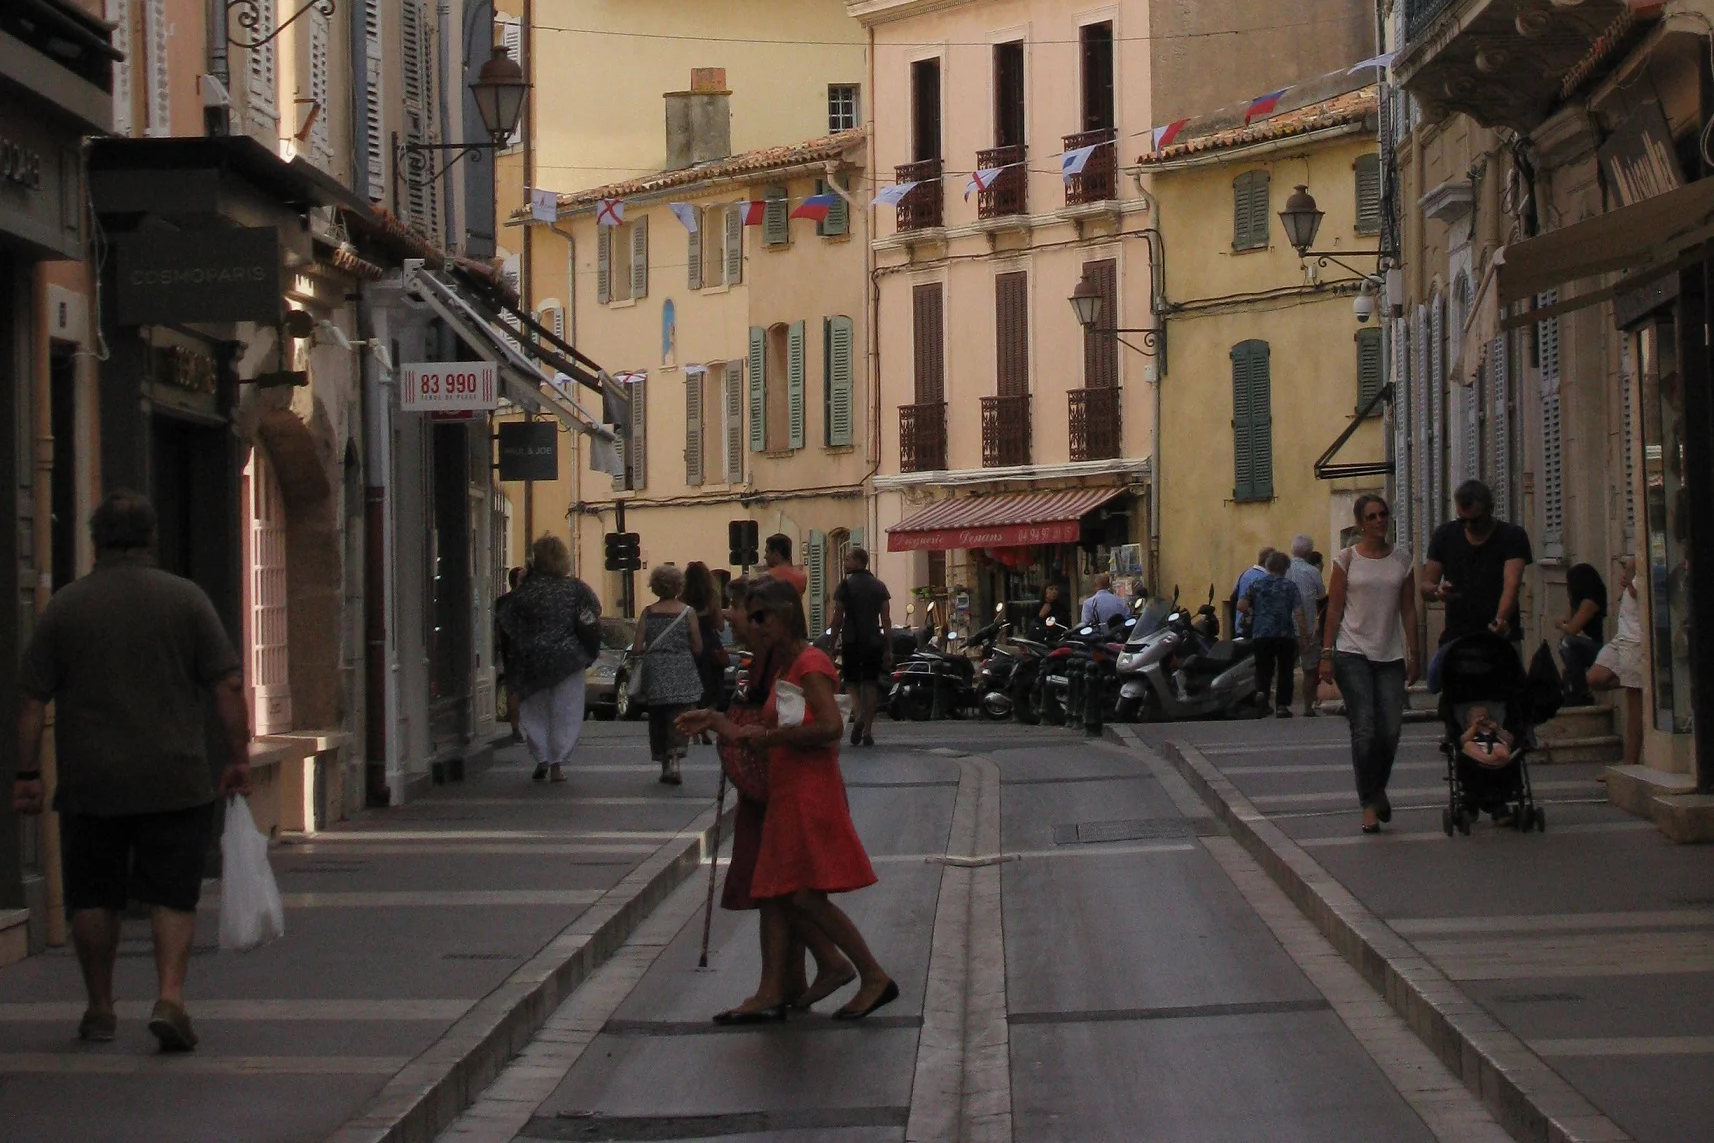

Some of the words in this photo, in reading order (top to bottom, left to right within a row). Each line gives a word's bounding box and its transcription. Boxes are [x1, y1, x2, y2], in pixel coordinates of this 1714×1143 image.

[131, 267, 266, 285] COSMOPARIS
[421, 375, 440, 394] 83
[446, 374, 476, 393] 990
[535, 446, 552, 455] JOE
[1029, 527, 1039, 541] 94
[1041, 526, 1050, 540] 97
